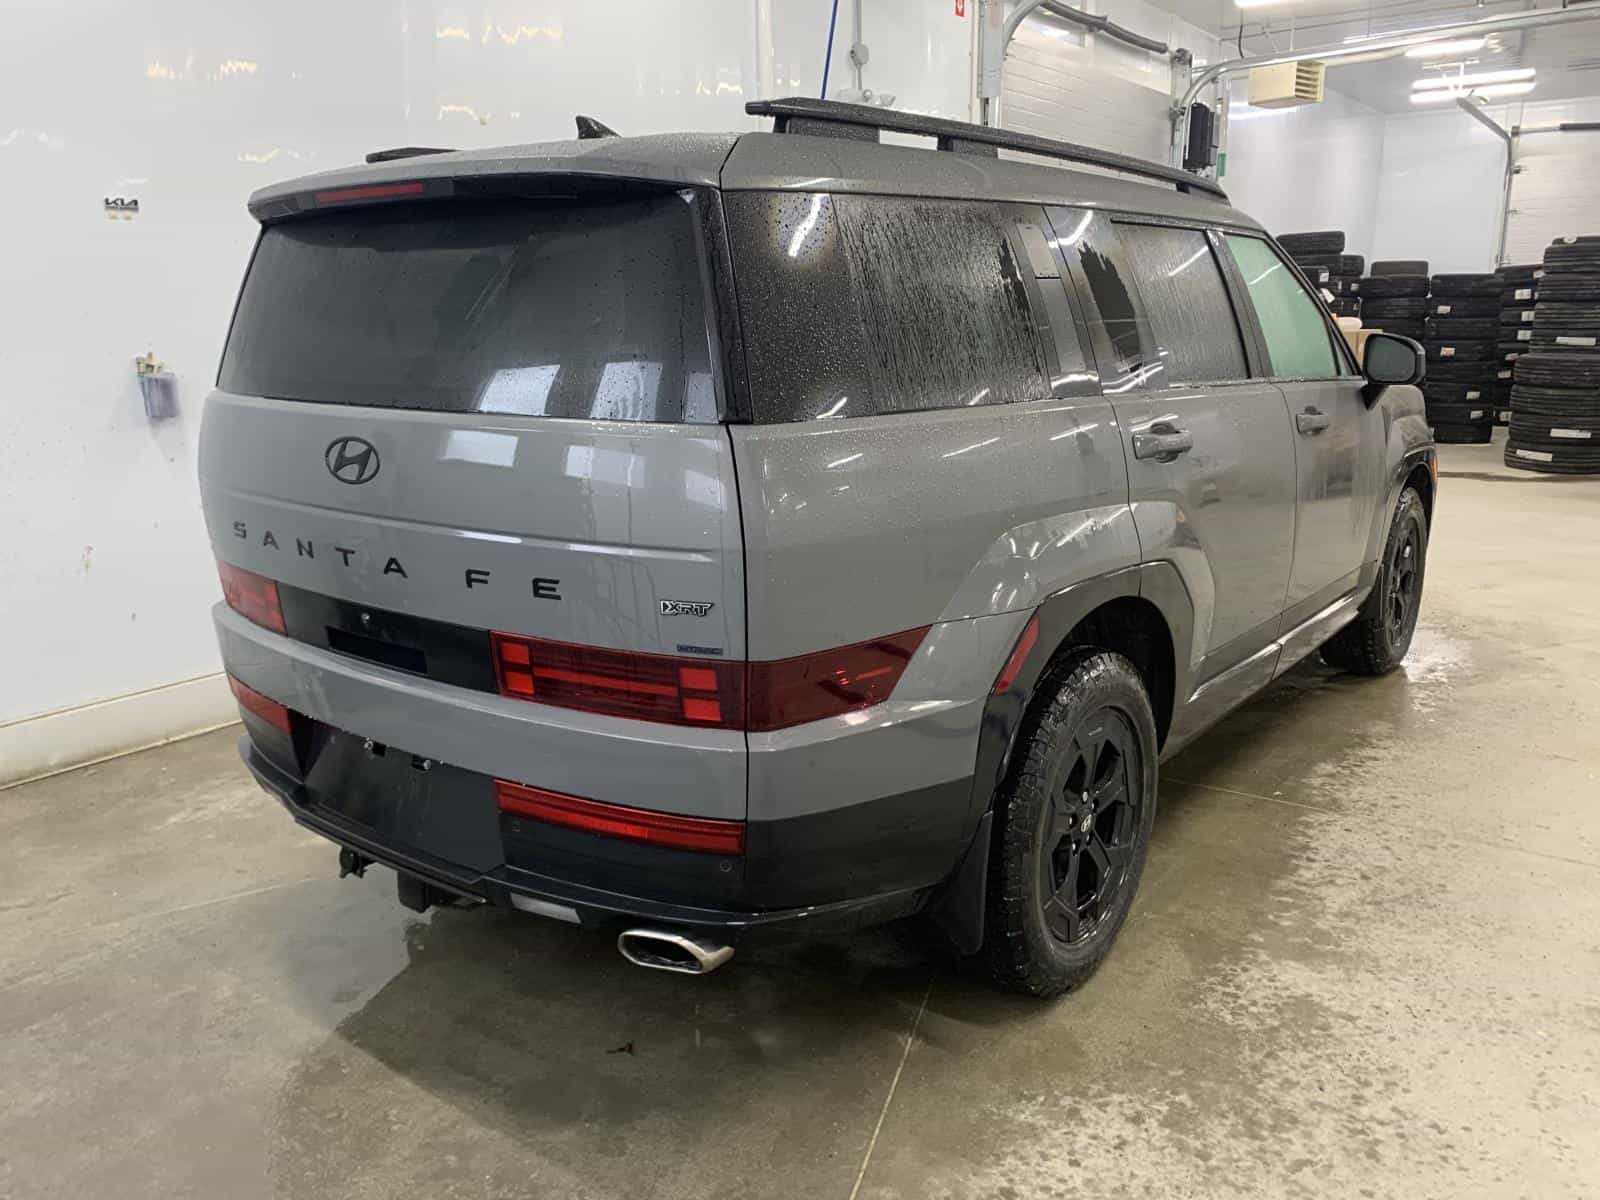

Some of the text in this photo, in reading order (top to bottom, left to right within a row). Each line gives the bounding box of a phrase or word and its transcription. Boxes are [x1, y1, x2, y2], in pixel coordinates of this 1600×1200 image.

[104, 197, 138, 209] KIA
[233, 521, 562, 600] SANTA FE
[660, 599, 714, 617] XRT
